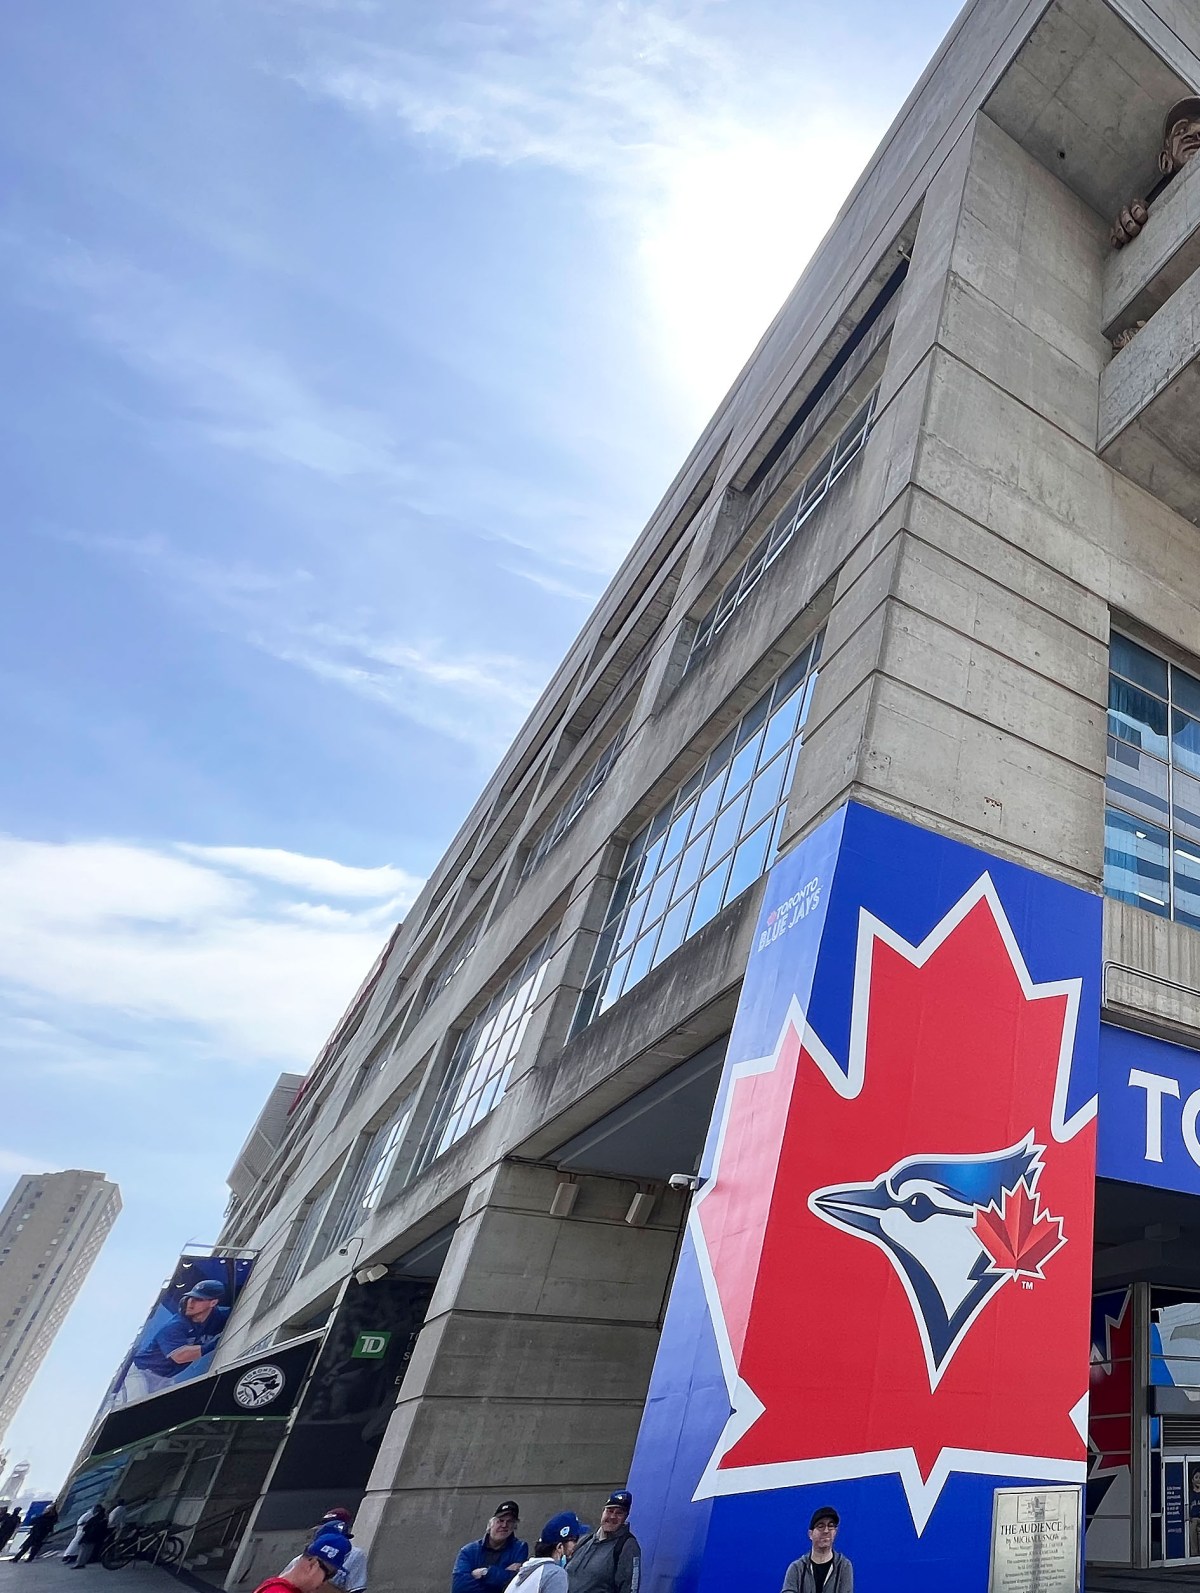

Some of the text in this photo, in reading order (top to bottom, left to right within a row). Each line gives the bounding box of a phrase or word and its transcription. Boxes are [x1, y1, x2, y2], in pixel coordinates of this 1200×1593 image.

[777, 876, 819, 919] TORONTO
[758, 887, 821, 952] BLUE JAYS
[1021, 1280, 1034, 1290] TM
[360, 1335, 386, 1353] TD
[1000, 1524, 1017, 1535] THE
[1019, 1521, 1063, 1534] AUDIENCE
